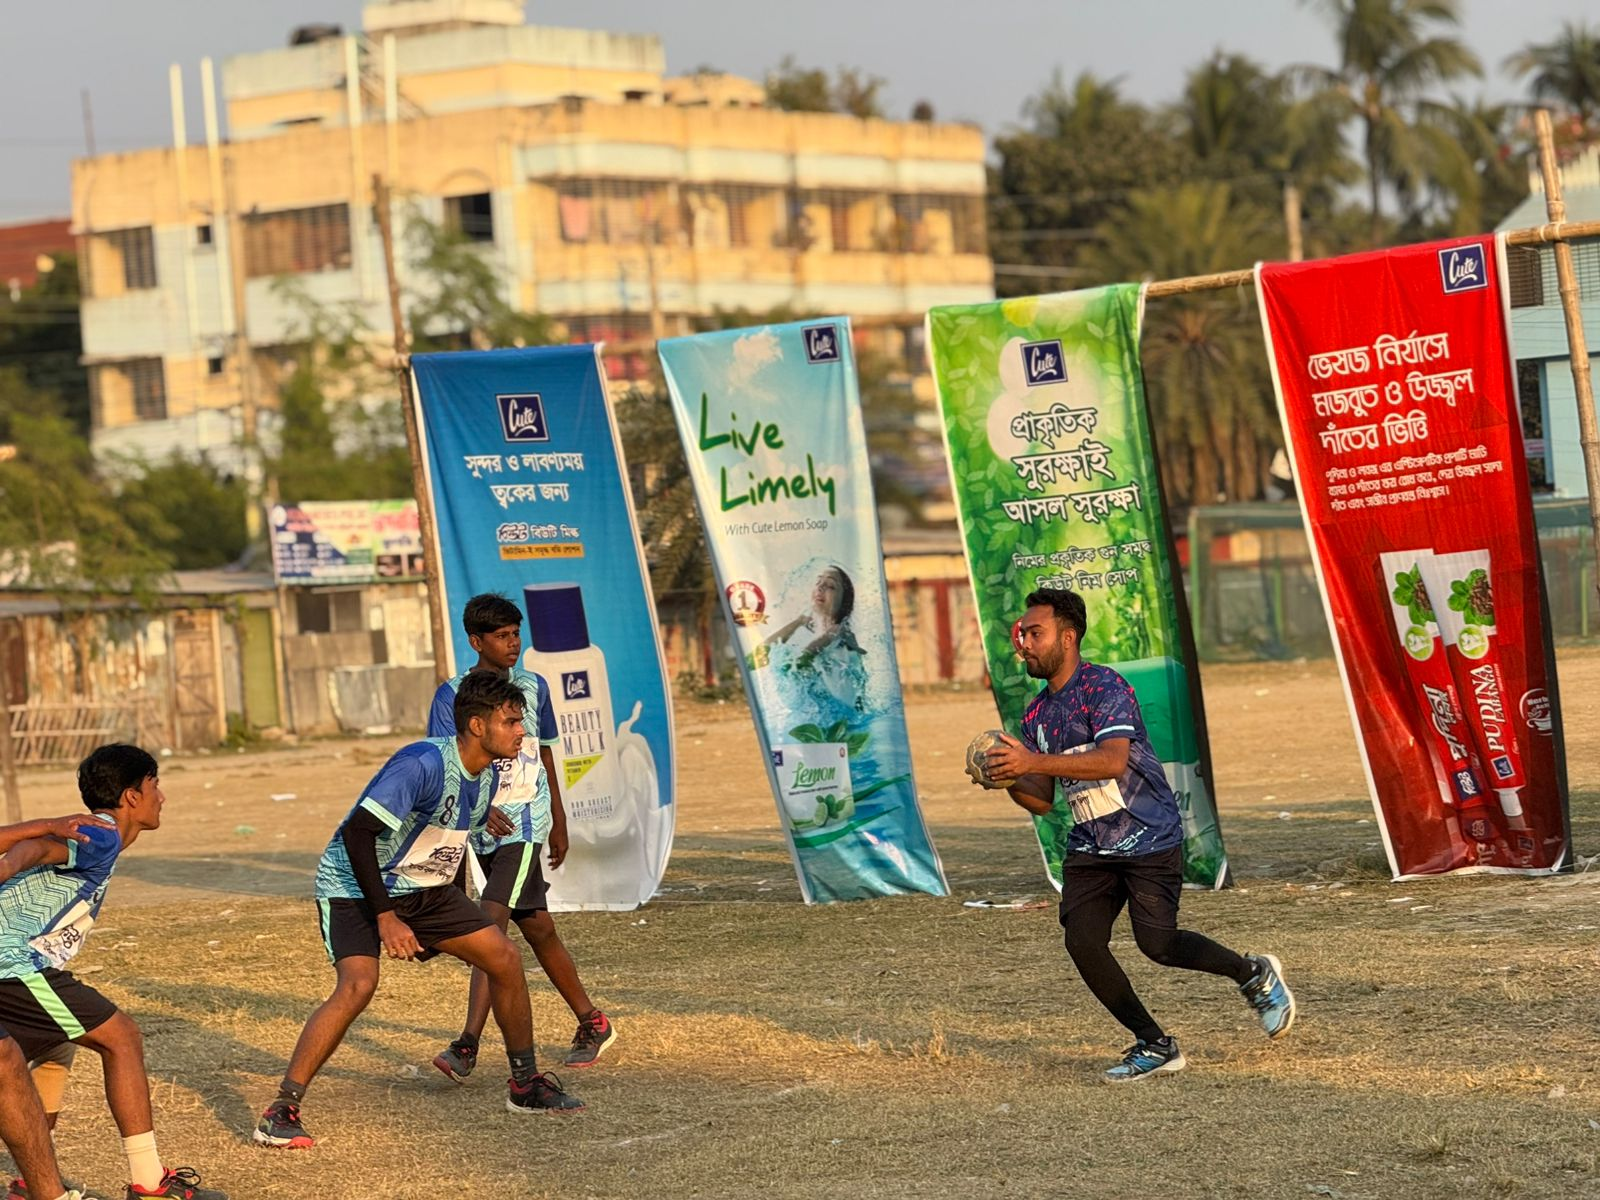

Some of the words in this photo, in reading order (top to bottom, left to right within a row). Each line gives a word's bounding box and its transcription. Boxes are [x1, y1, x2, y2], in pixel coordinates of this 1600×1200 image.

[1448, 250, 1478, 286] Cute
[810, 329, 833, 359] Cute
[1307, 346, 1370, 380] ভেষজ
[1373, 330, 1450, 370] নির্যাসে
[1030, 347, 1058, 379] Cute
[1312, 383, 1379, 418] মজবুত
[1385, 380, 1402, 406] ও
[1405, 368, 1475, 407] উজ্জ্বল
[508, 398, 538, 437] Cute
[699, 392, 785, 456] Live
[1010, 403, 1098, 448] প্রাকৃতিক
[1318, 422, 1379, 455] দাঁতের
[1382, 409, 1429, 447] ভিত্তি
[464, 454, 503, 479] সুন্দর
[506, 456, 520, 471] ও
[521, 453, 584, 473] লাবণ্যময়
[1011, 440, 1115, 493] সুরক্ষাই
[1349, 467, 1357, 478] ও
[490, 484, 536, 509] ত্বকের
[538, 483, 569, 502] জন্য
[720, 453, 836, 516] Limely
[1002, 495, 1068, 526] আসল
[1070, 481, 1143, 525] সুরক্ষা
[530, 525, 558, 540] বিউটি
[725, 522, 750, 536] With
[752, 521, 772, 534] Cute
[774, 520, 805, 533] Lemon
[806, 518, 828, 532] Soap
[1012, 552, 1046, 570] নিমের
[1100, 545, 1119, 560] গুন
[1122, 539, 1152, 558] সমৃদ্ধ
[1036, 573, 1073, 591] কিউট
[1075, 571, 1101, 590] নিম
[1105, 567, 1140, 588] সোপ
[560, 710, 602, 734] BEAUTY
[1470, 664, 1506, 753] PUDINA
[563, 732, 605, 755] MILK
[791, 761, 836, 789] Lemon
[439, 794, 455, 826] 8
